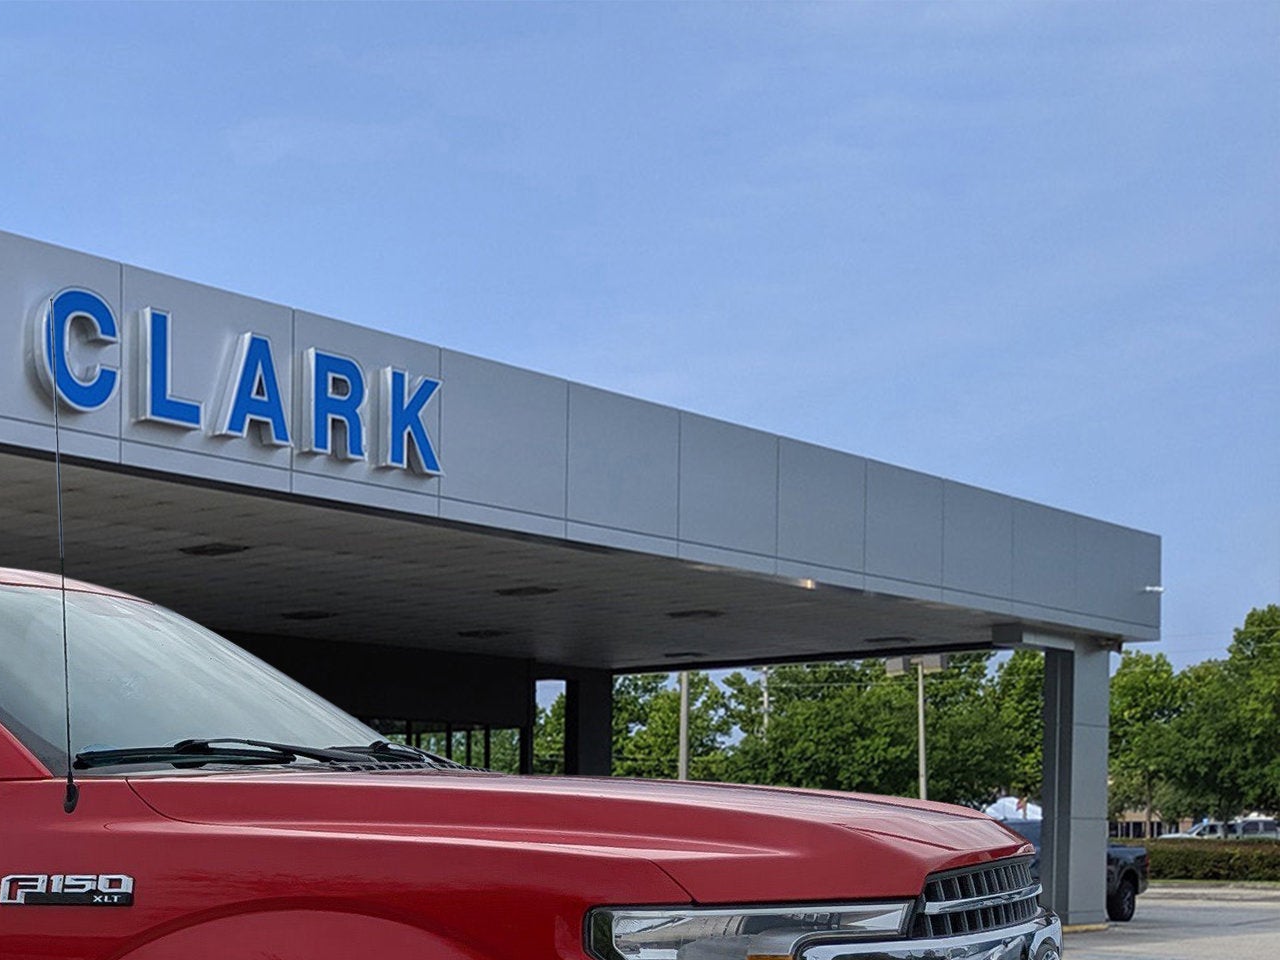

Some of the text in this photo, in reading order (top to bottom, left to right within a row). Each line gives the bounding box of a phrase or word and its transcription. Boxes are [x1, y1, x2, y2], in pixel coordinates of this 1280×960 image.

[34, 286, 445, 476] CLARK
[0, 874, 134, 904] F150
[92, 894, 121, 903] XLT
